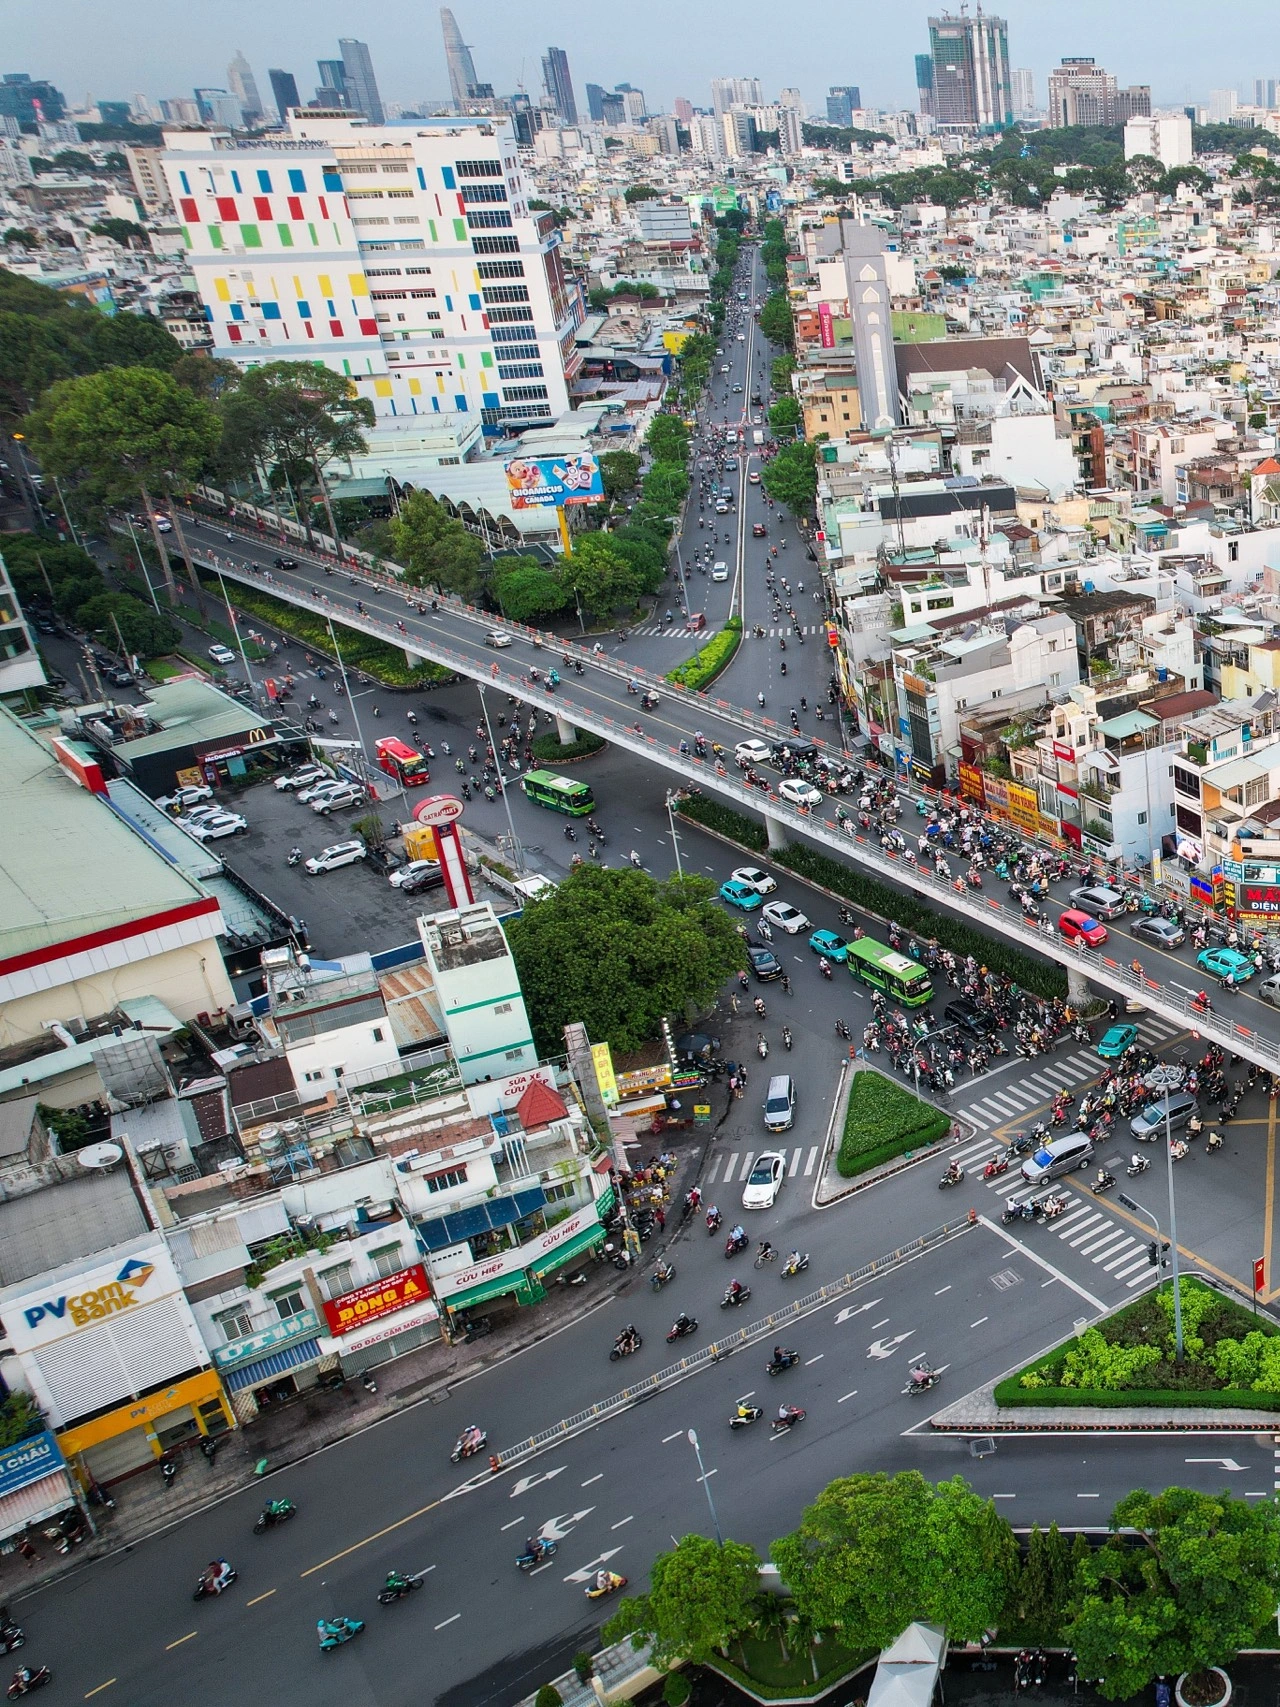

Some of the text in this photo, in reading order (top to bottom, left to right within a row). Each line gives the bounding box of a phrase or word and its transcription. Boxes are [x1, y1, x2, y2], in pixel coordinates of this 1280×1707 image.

[513, 486, 563, 496] BIOAMICUS
[525, 496, 554, 504] CANADA
[205, 750, 241, 762] McDonald's
[424, 807, 457, 821] SATRAMART
[1252, 901, 1278, 912] ĐIỆN
[508, 1072, 541, 1087] SỬA XE
[562, 1220, 580, 1235] HIỆP
[481, 1263, 504, 1276] HIỆP
[338, 1289, 397, 1322] ĐÔNG
[404, 1278, 418, 1295] Á
[70, 1290, 139, 1327] Bank
[6, 1444, 50, 1468] CHÂU
